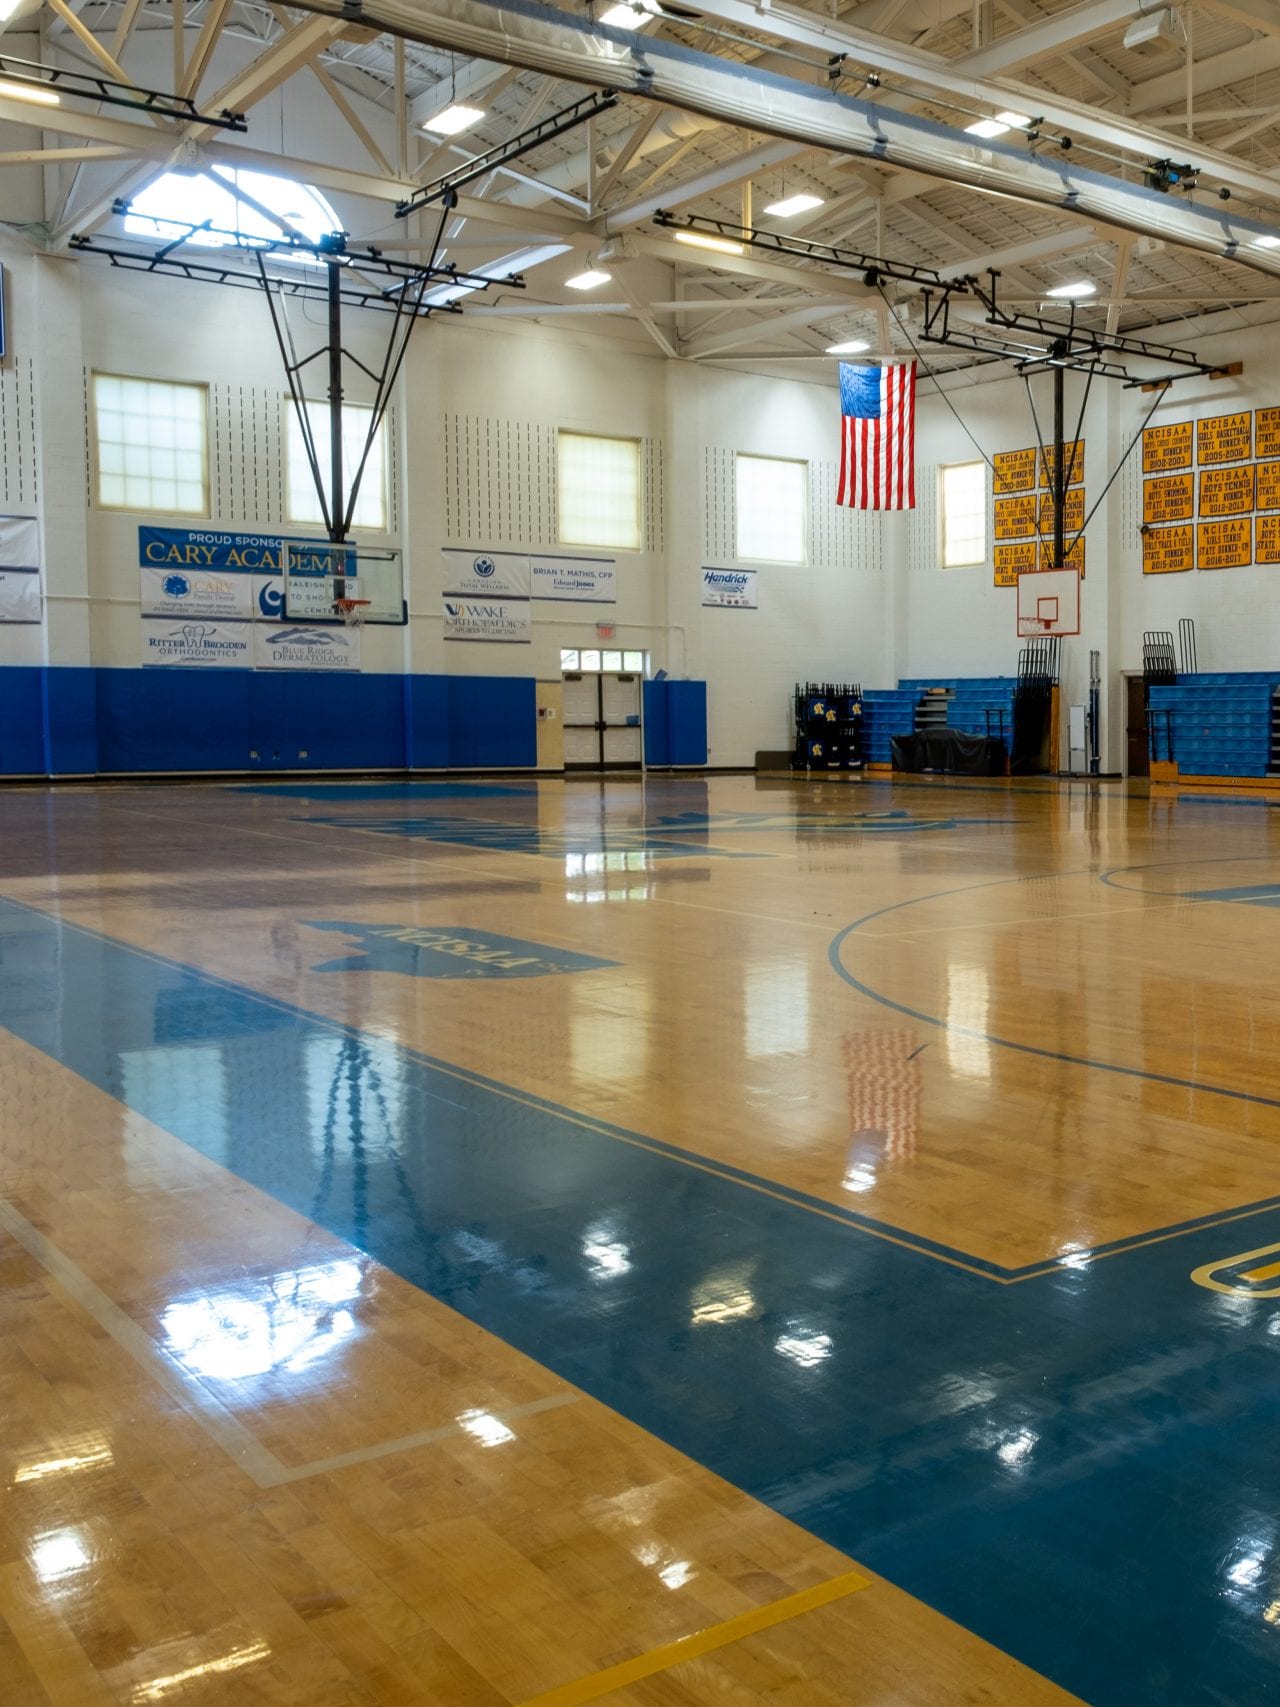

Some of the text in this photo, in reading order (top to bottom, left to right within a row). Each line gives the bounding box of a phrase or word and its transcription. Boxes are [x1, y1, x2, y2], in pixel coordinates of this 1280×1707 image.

[189, 532, 284, 548] PROUD SPONSO
[146, 542, 334, 572] CARY ACADEM
[533, 568, 558, 576] BRIAN
[704, 572, 748, 584] Hendrick
[193, 580, 234, 592] CARY
[304, 606, 332, 616] CENTE
[466, 605, 507, 618] WAKE
[149, 638, 247, 650] RITTER BROGDEN
[159, 648, 238, 657] ORTHODONTICS
[272, 650, 350, 662] DERMATOLOGY
[282, 645, 335, 656] BLUE RIDGE
[367, 927, 541, 968] NCISAA
